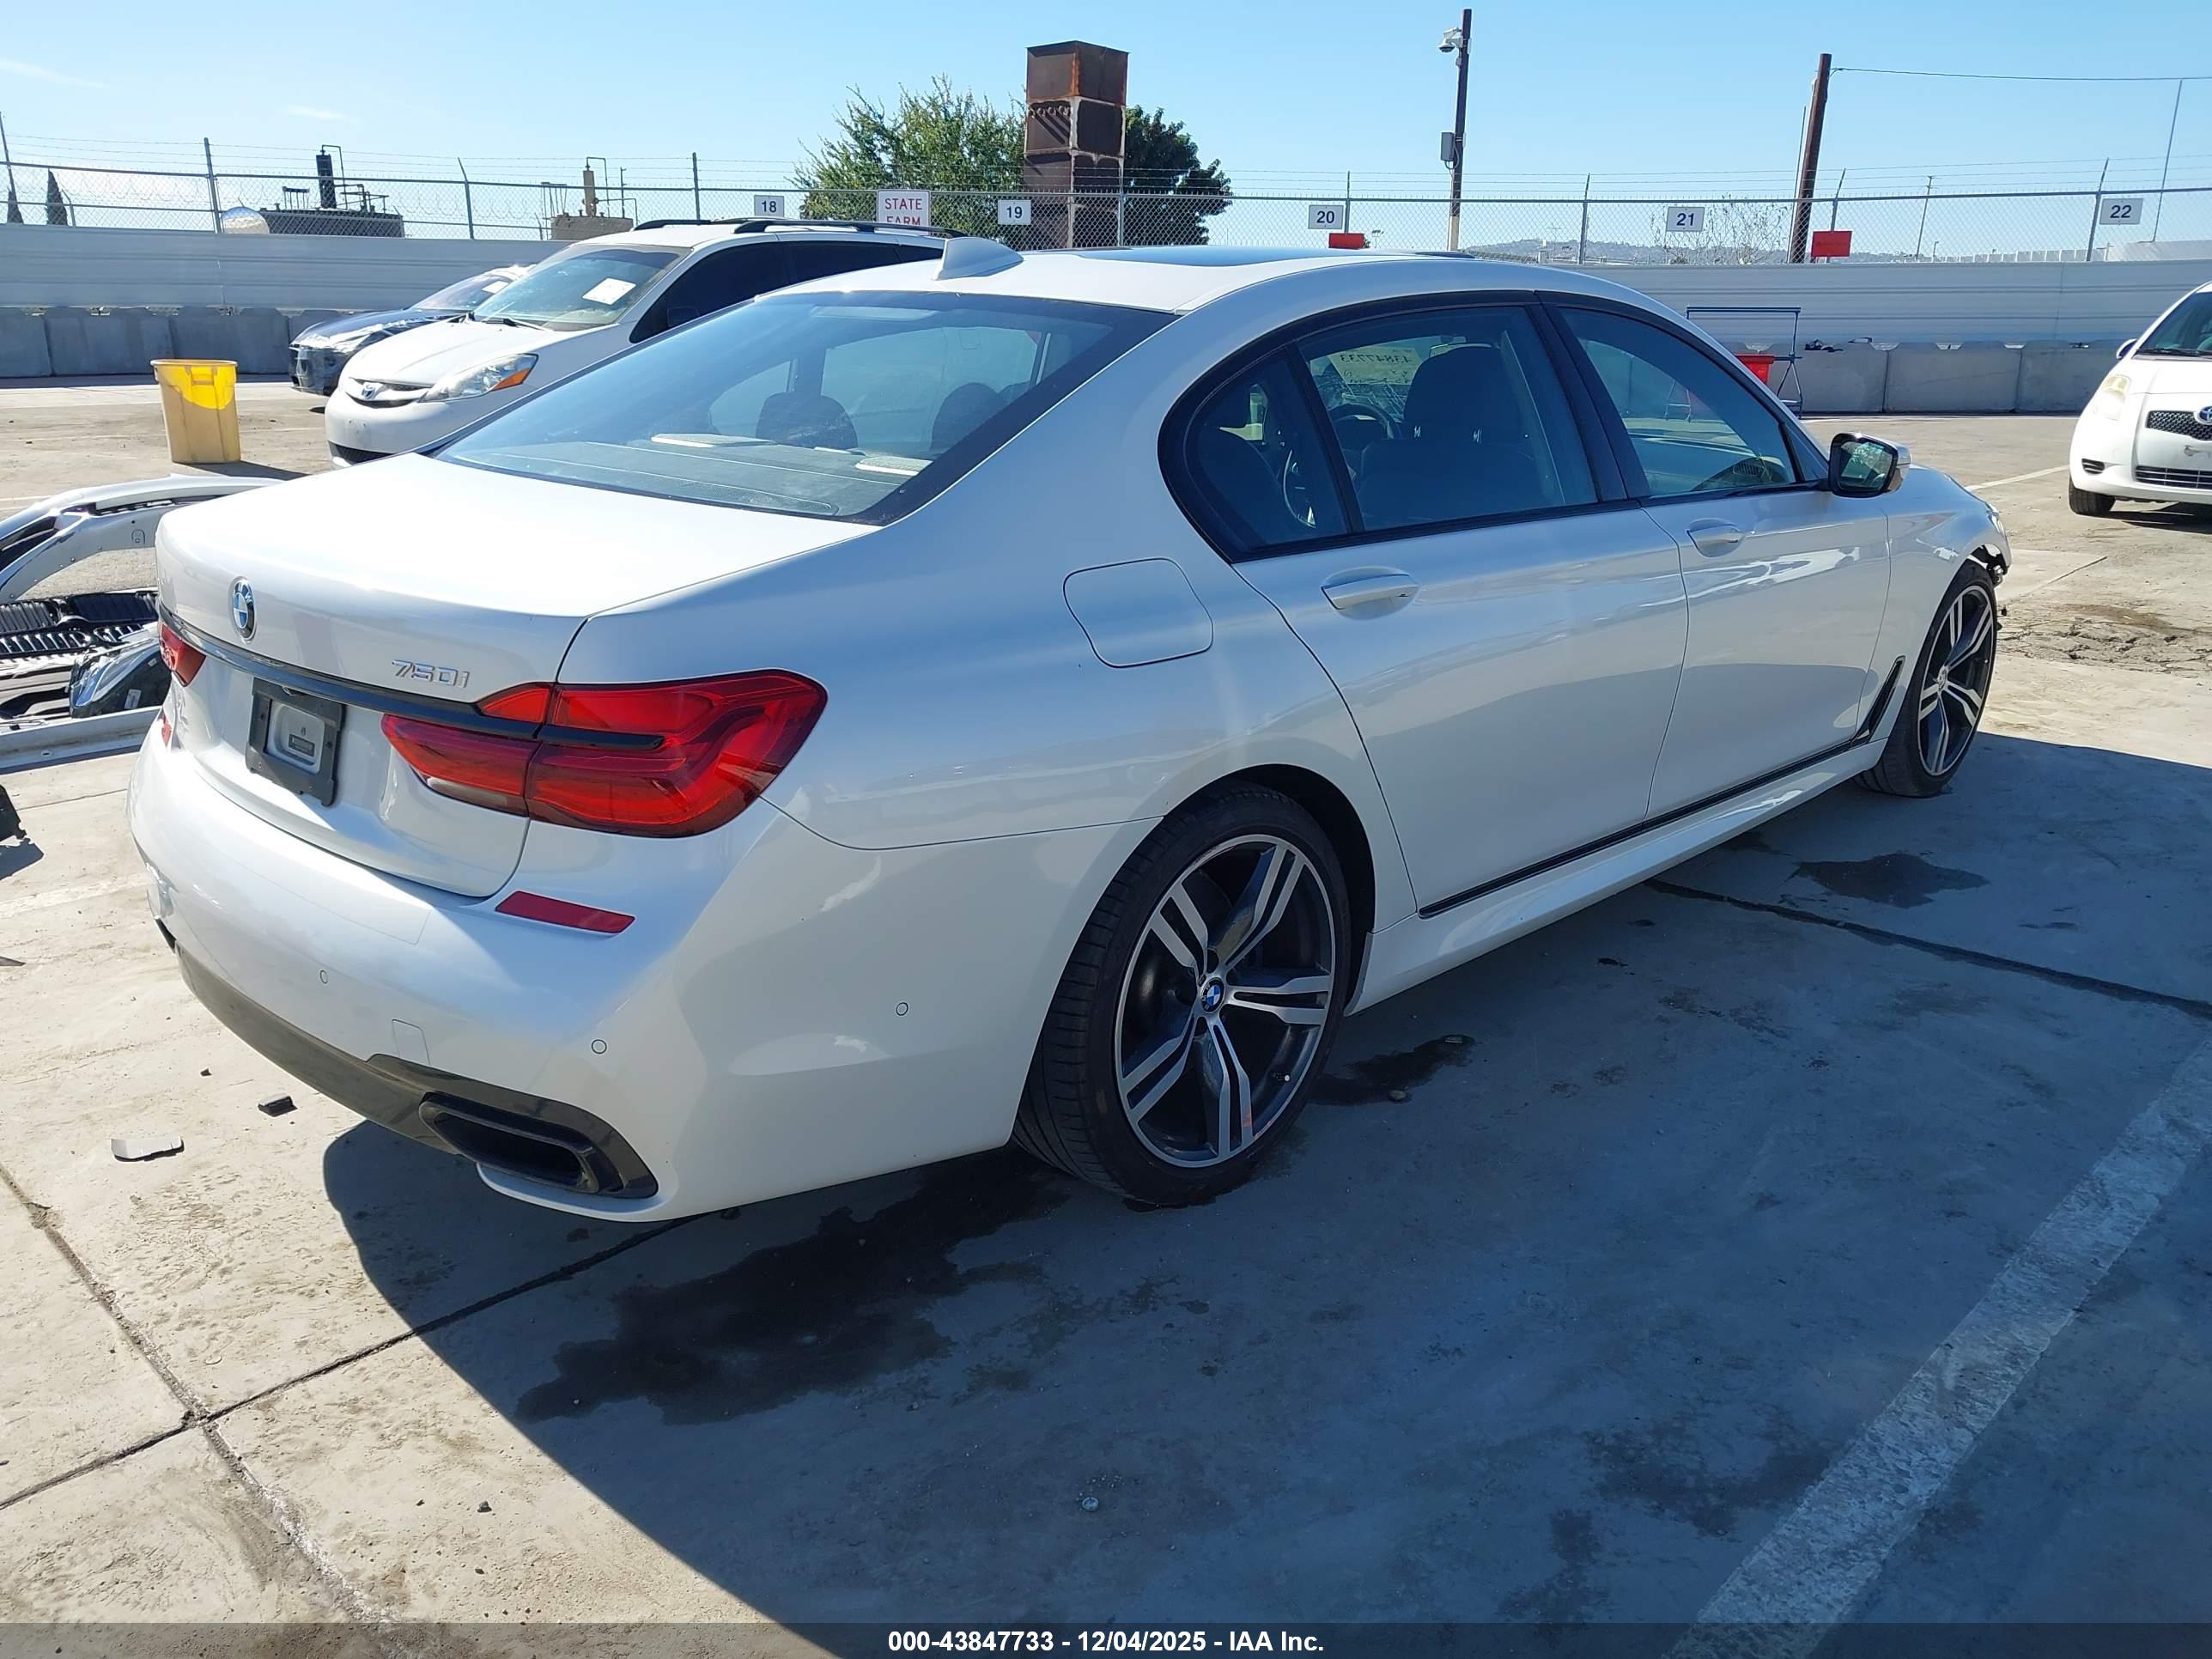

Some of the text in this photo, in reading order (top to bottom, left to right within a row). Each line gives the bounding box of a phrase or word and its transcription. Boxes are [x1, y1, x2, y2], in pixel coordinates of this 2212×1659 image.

[761, 200, 777, 213] 18
[884, 198, 922, 210] STATE
[2110, 204, 2132, 218] 22
[1006, 206, 1022, 219] 19
[1316, 210, 1335, 224] 20
[1676, 212, 1695, 226] 21
[392, 659, 470, 689] 750i
